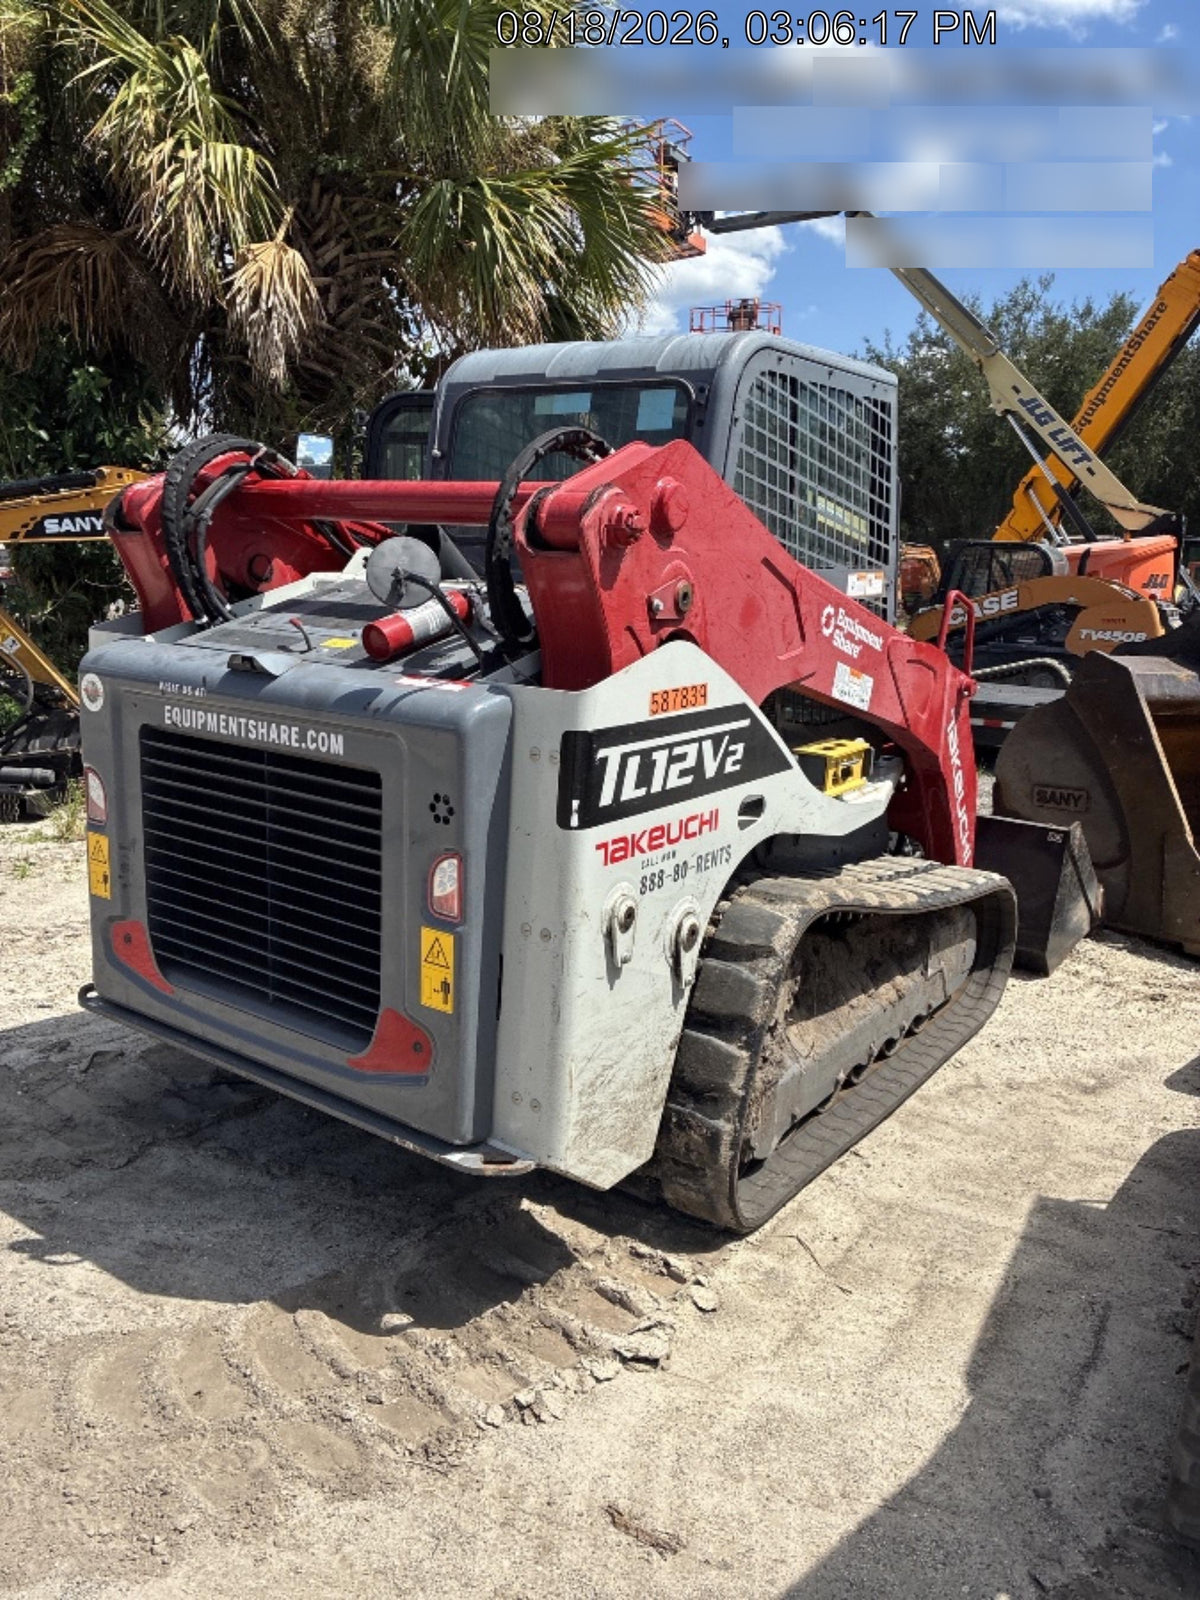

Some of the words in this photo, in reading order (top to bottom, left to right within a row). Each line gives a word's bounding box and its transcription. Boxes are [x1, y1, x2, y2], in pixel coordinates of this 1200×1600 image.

[1073, 302, 1167, 435] EquipmentShare
[1017, 397, 1057, 428] JLG
[1047, 427, 1094, 465] LIFT
[43, 516, 104, 534] SANY
[832, 629, 863, 659] Share
[836, 607, 884, 652] Equipment
[164, 705, 345, 757] EQUIPMENTSHARE.COM
[1035, 787, 1086, 810] SANY
[639, 844, 734, 896] 888-80-RENTS
